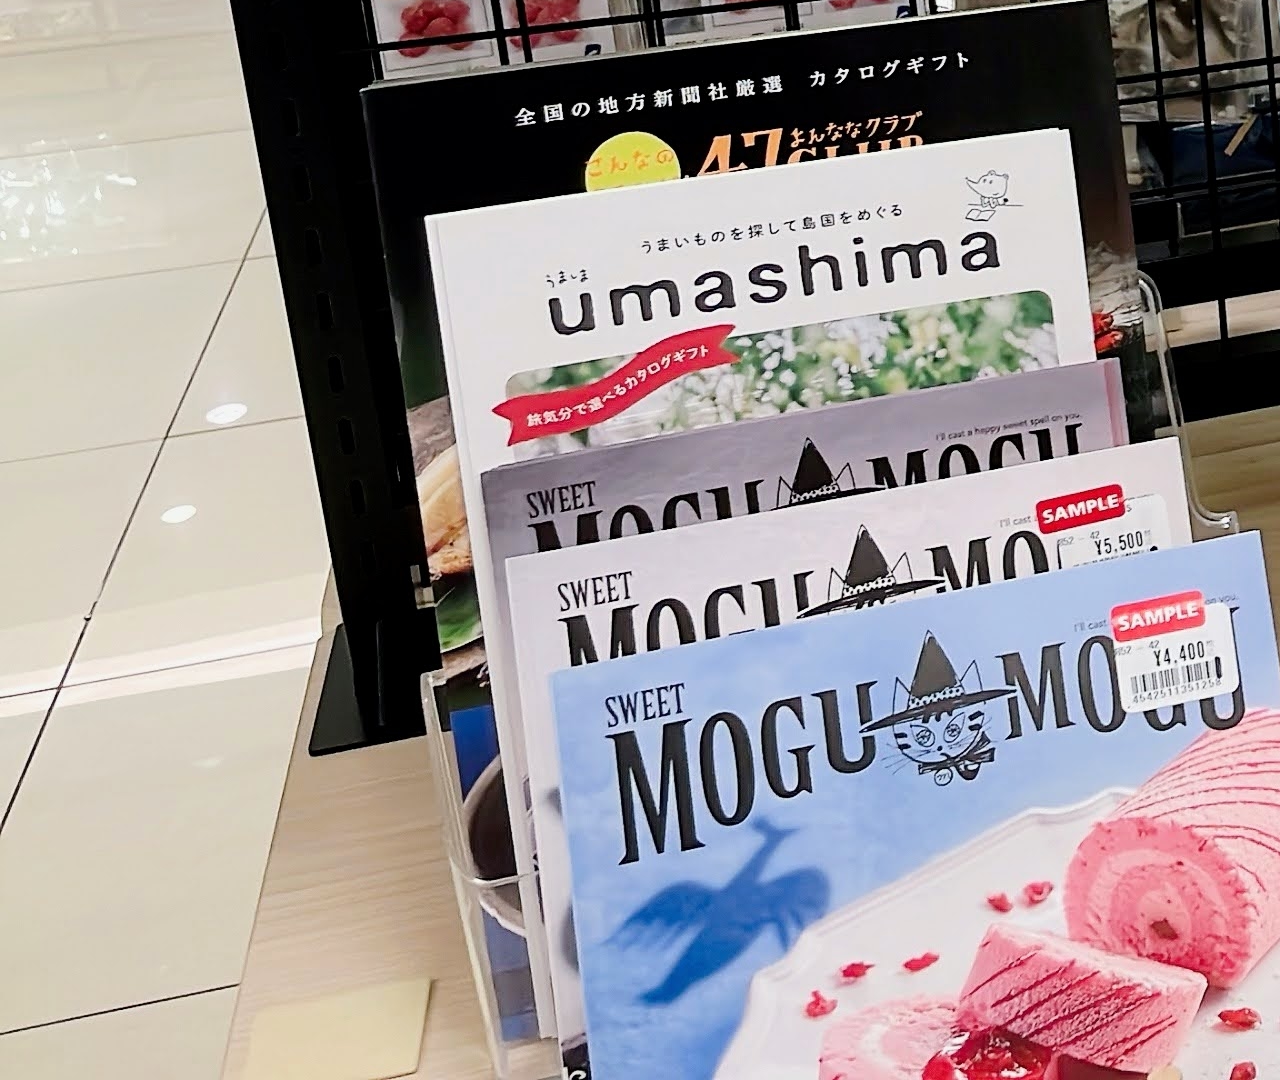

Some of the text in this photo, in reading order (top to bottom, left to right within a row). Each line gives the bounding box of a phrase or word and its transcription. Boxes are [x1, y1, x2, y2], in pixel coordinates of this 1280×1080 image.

[514, 50, 972, 127] 全国の地方新聞社厳選 カタログギフト
[641, 203, 904, 254] うまいものを探して島国をめぐる
[545, 268, 590, 289] うましま
[547, 226, 1001, 336] umashima
[526, 344, 711, 427] 旅気分で選べるカタログギフト
[527, 480, 597, 519] SWEET
[1042, 494, 1120, 524] SAMPLE
[558, 571, 633, 613] SWEET
[1118, 601, 1200, 632] SAMPLE
[604, 683, 685, 725] SWEET
[605, 679, 878, 865] MOGU
